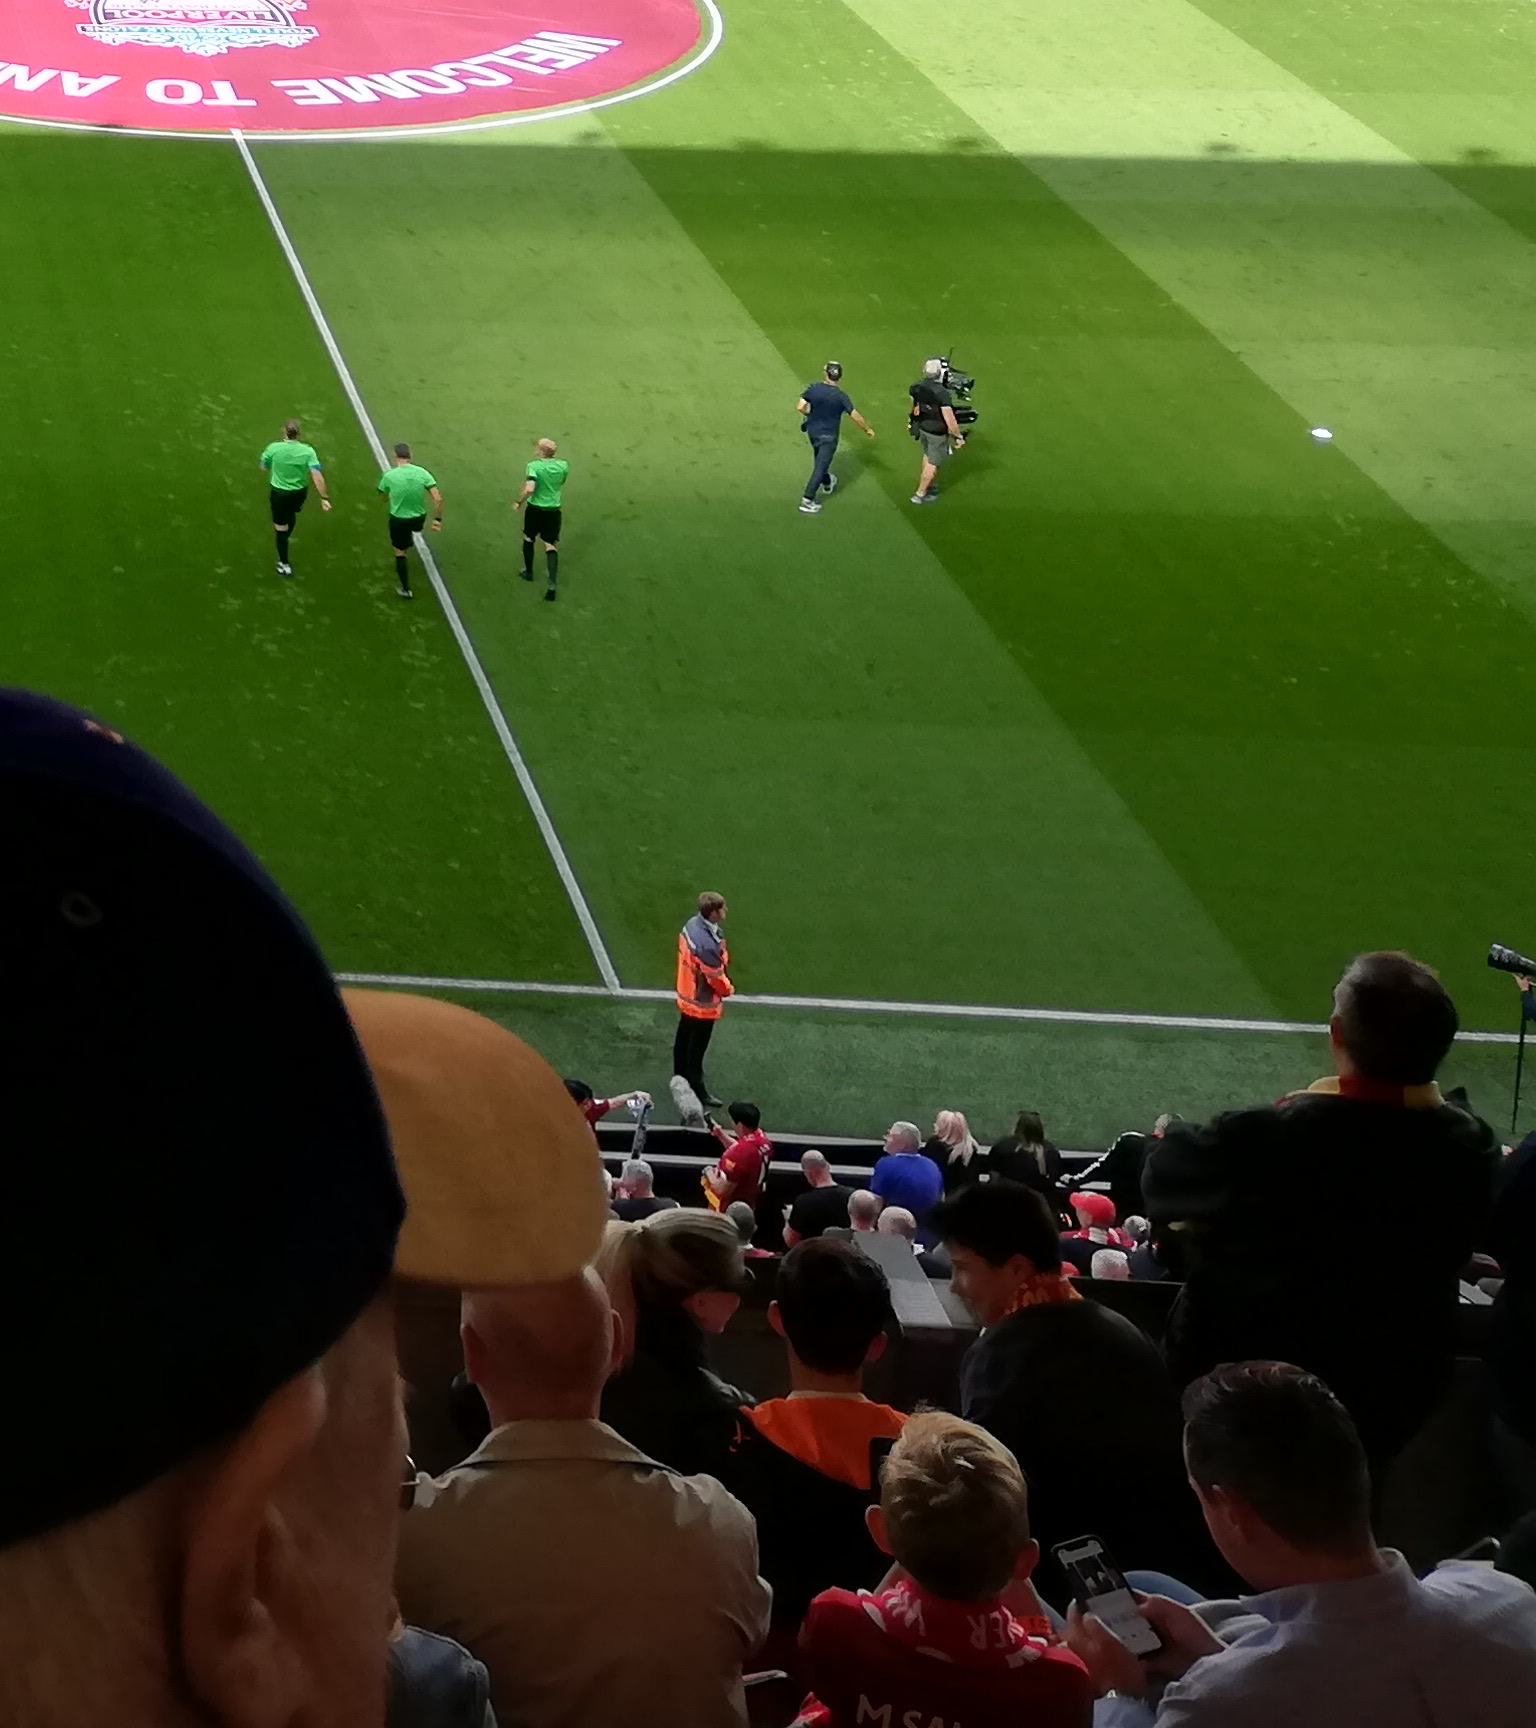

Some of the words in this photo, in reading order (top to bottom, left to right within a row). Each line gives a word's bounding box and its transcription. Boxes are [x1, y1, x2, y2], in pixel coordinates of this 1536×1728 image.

[105, 9, 274, 21] LIVERPOOL
[271, 30, 623, 106] WELCOME
[145, 77, 257, 107] TO
